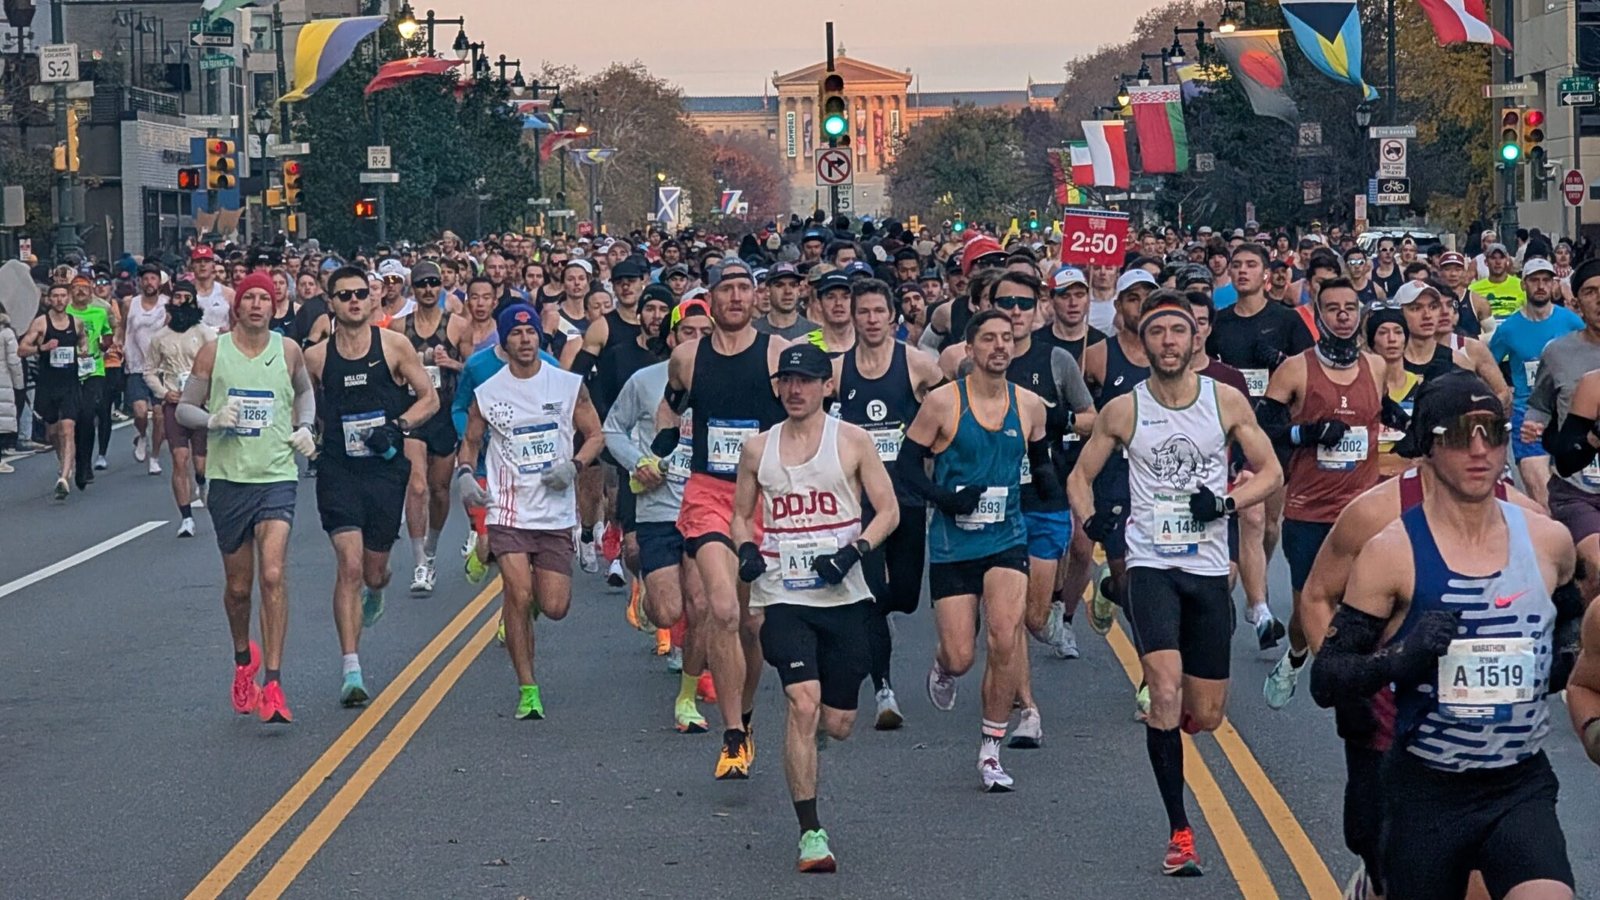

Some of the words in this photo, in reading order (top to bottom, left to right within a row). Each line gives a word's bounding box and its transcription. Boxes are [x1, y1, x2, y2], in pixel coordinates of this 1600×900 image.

[48, 60, 70, 77] S-2
[372, 155, 386, 166] R-2
[1070, 231, 1118, 254] 2:50
[243, 410, 267, 420] 1262
[871, 404, 883, 417] R
[349, 432, 357, 442] A
[522, 446, 529, 456] A
[532, 442, 554, 455] 1622
[713, 441, 721, 453] A
[875, 442, 899, 453] 2081
[671, 454, 676, 465] A
[772, 491, 837, 521] DOJO
[1162, 520, 1171, 533] A
[789, 556, 797, 569] A
[1472, 644, 1506, 653] MARATHON
[1453, 665, 1468, 687] A
[1475, 664, 1523, 687] 1519
